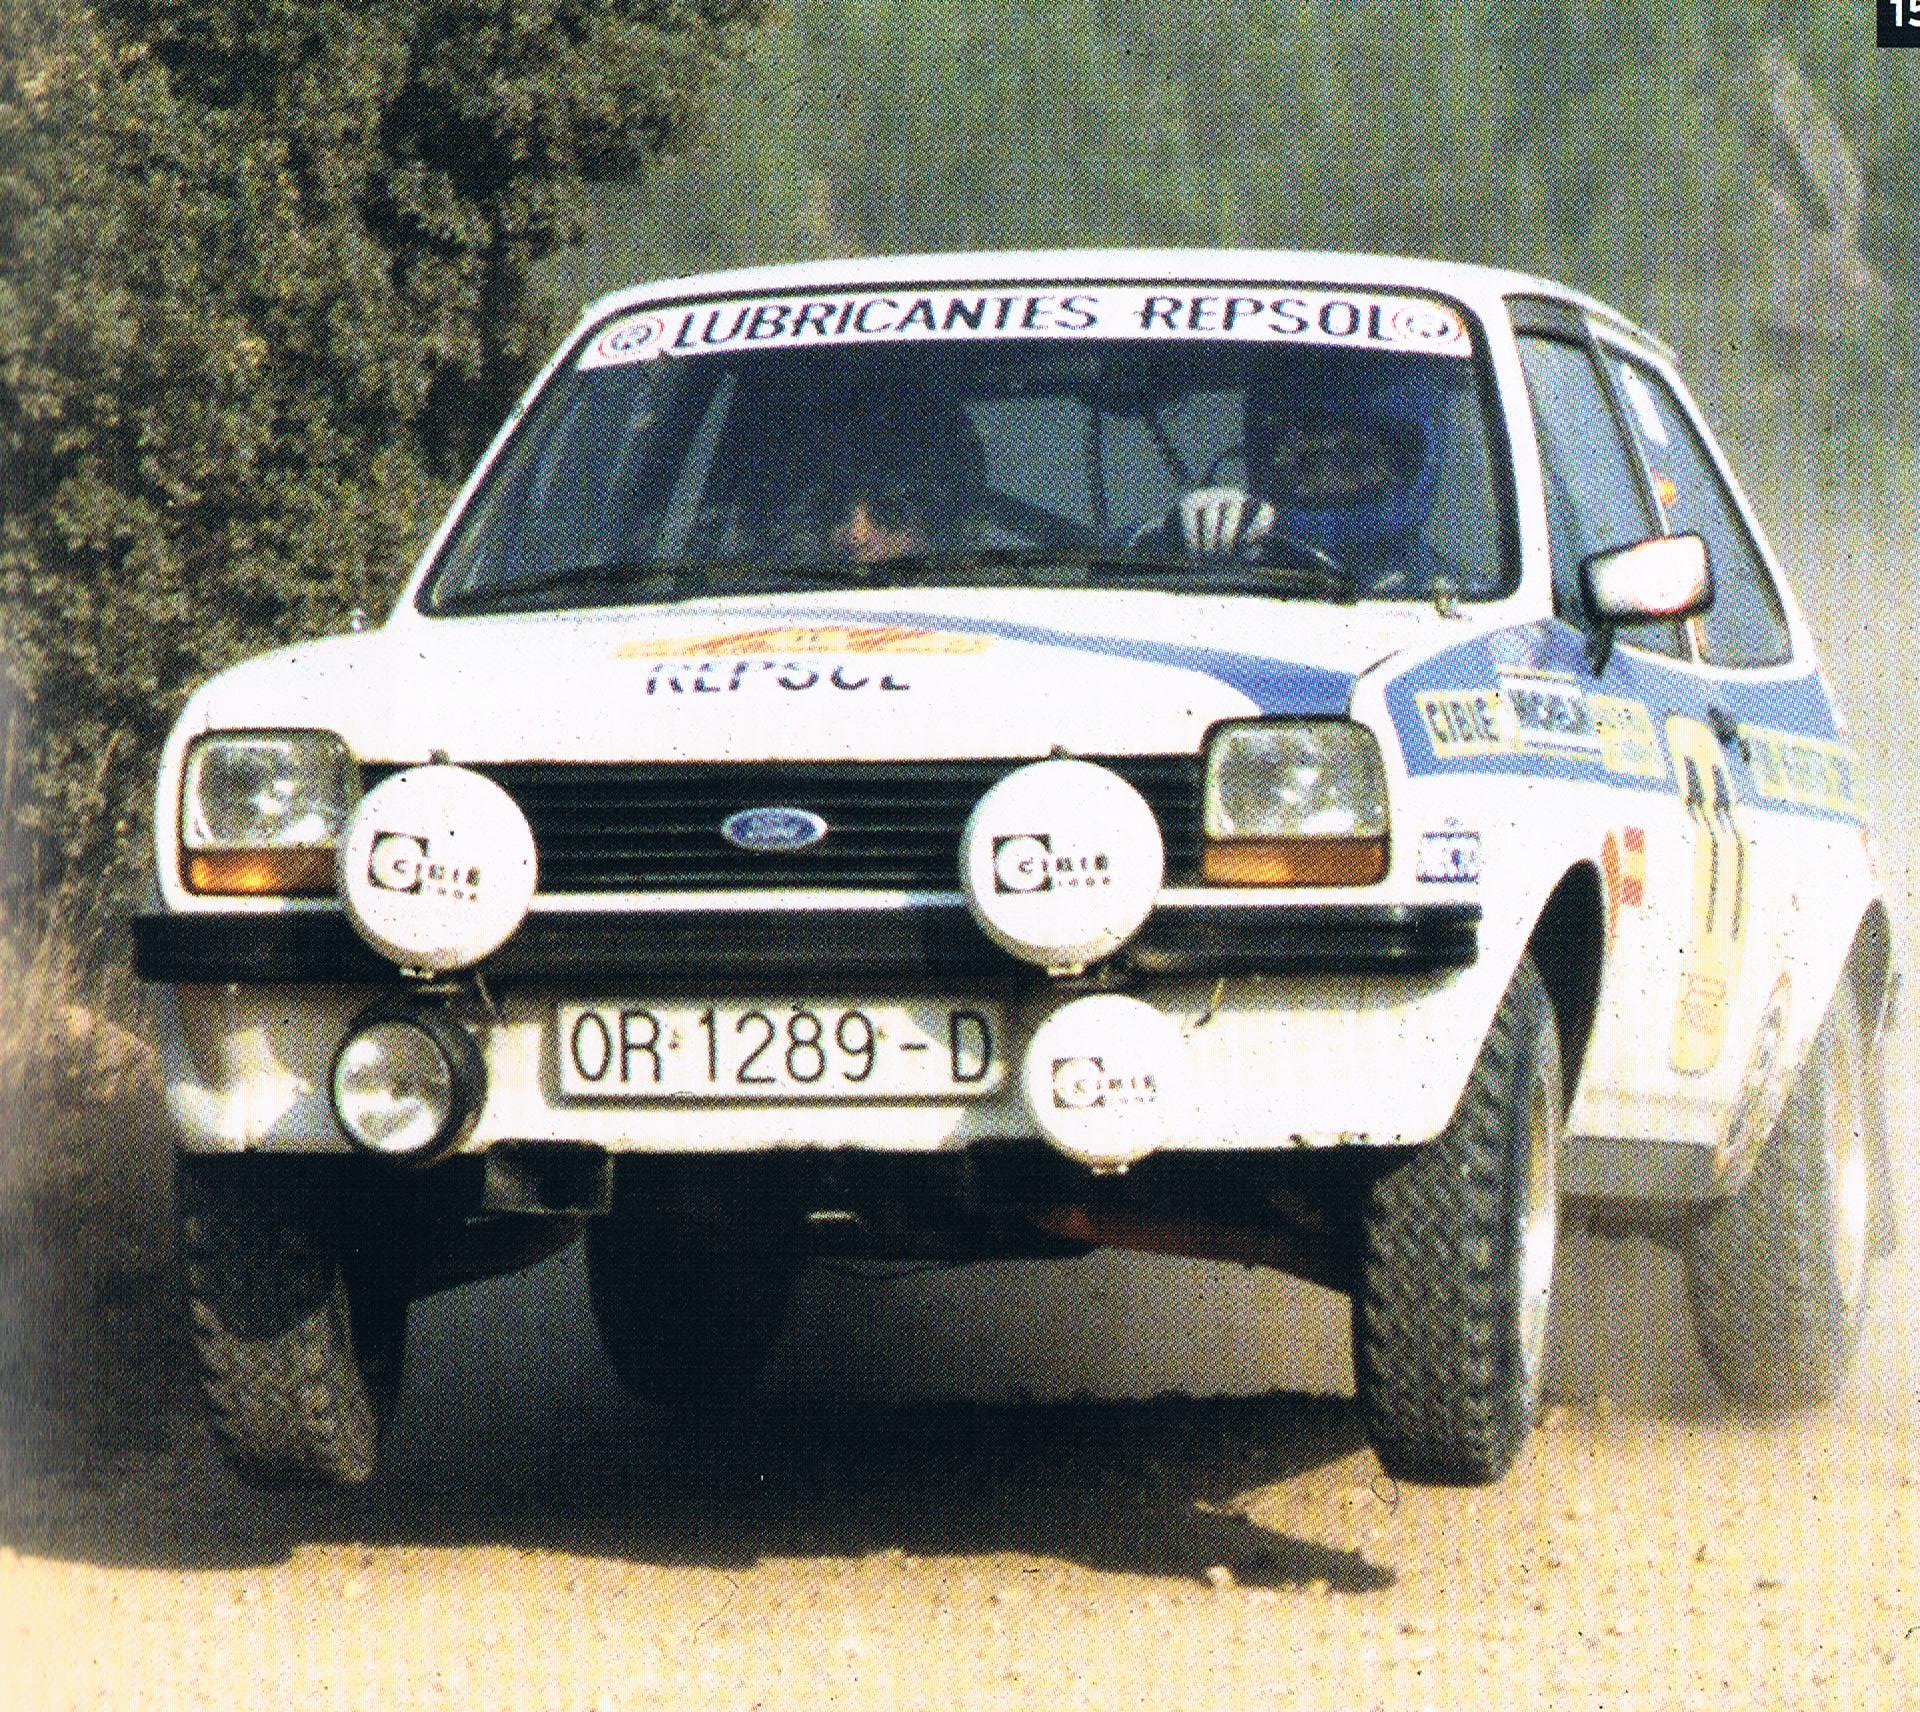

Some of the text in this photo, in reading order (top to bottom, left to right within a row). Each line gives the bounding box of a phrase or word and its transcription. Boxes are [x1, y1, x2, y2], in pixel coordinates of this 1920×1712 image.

[672, 294, 1400, 349] LUBRICANTES REPSOL
[571, 1010, 661, 1083] OR
